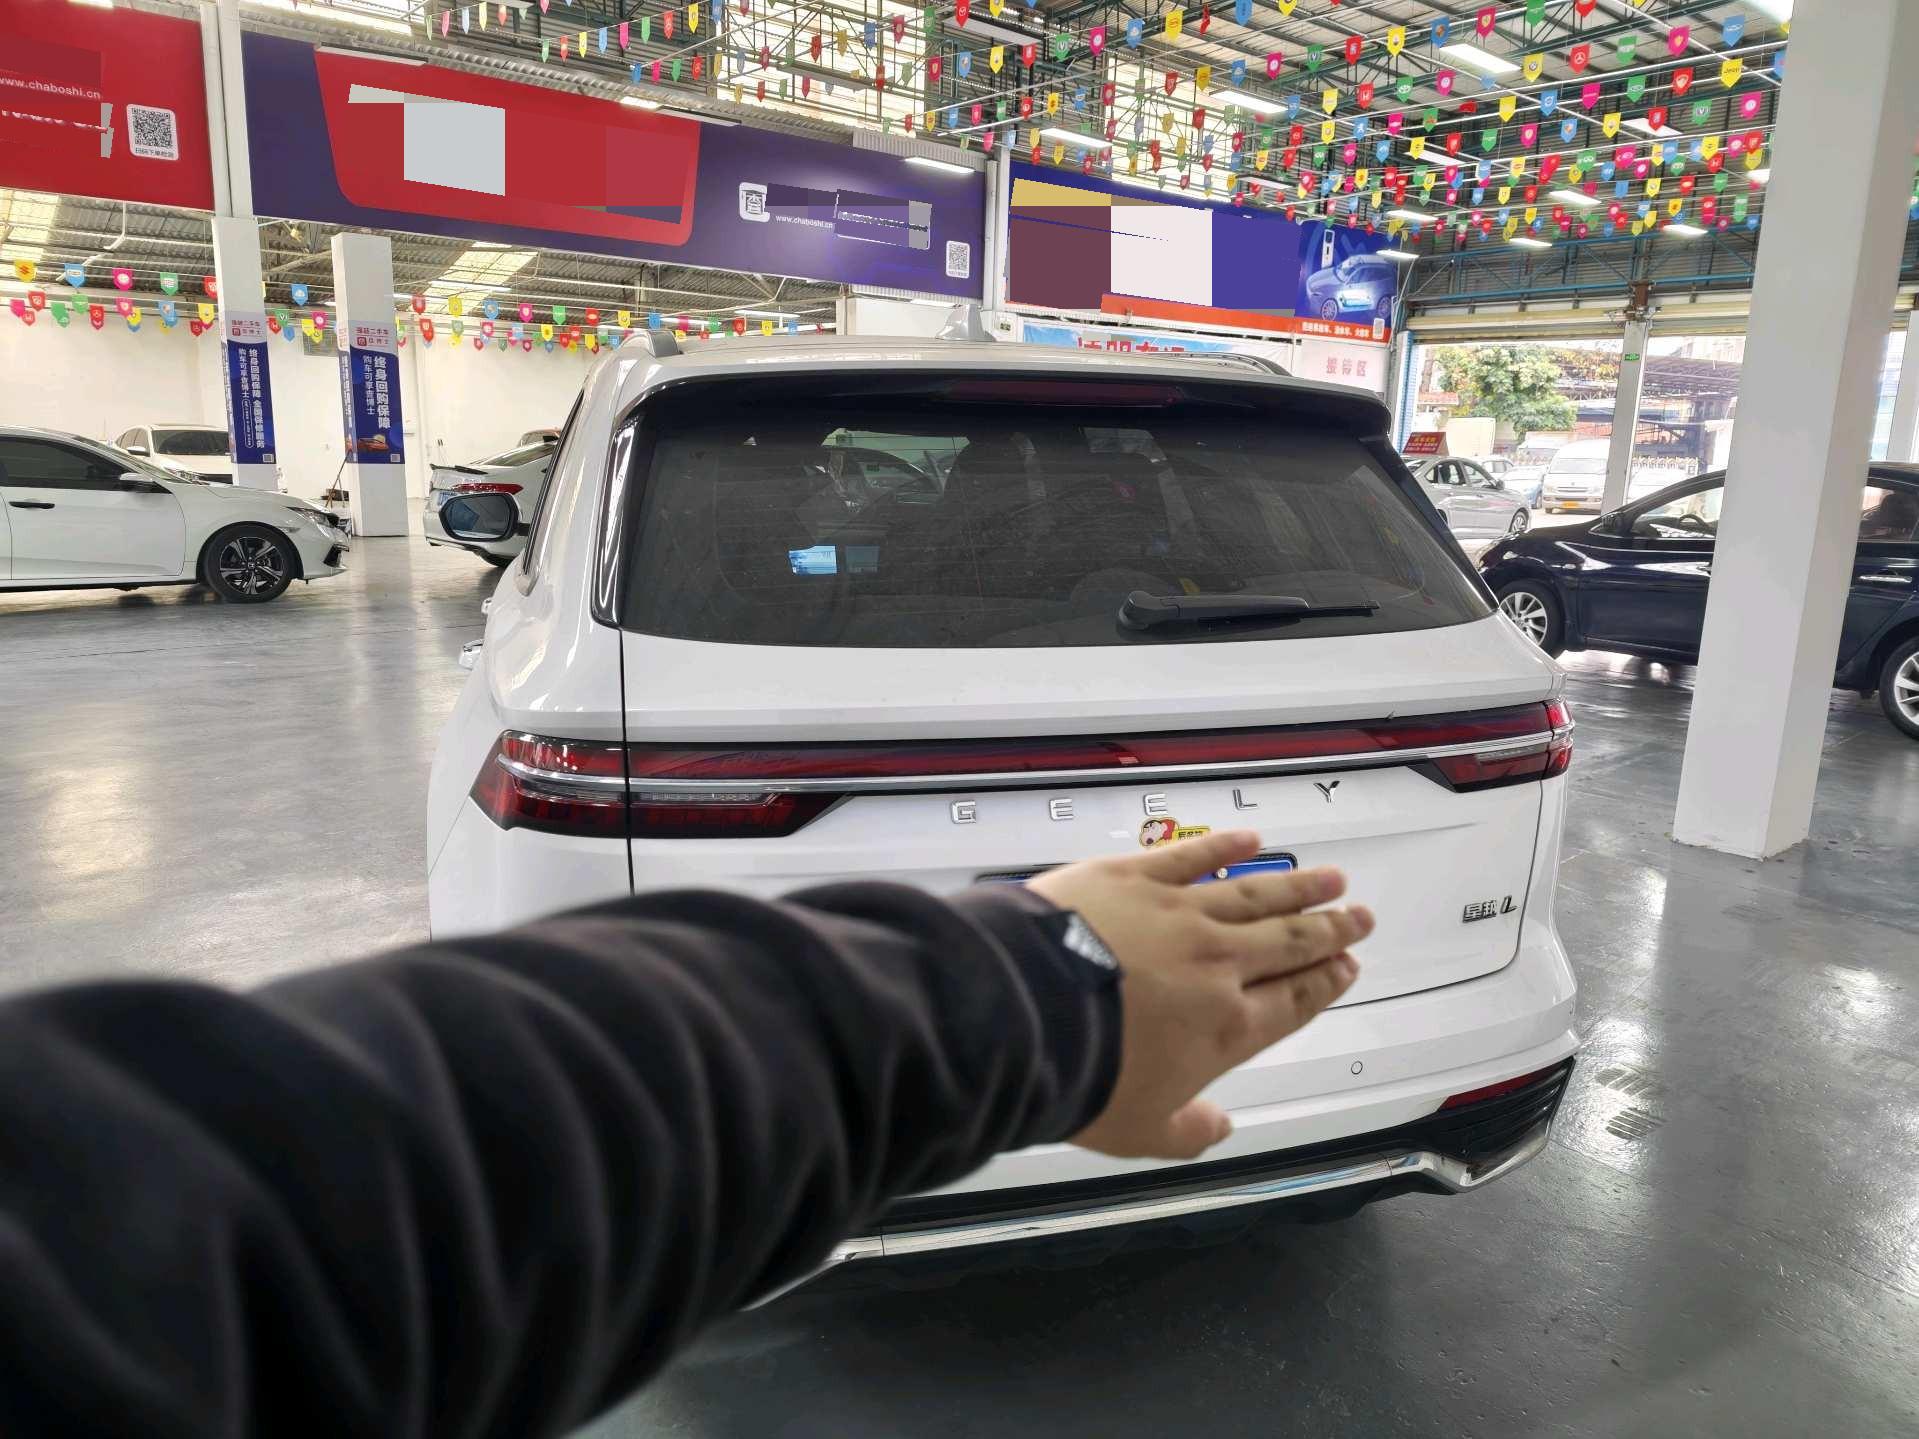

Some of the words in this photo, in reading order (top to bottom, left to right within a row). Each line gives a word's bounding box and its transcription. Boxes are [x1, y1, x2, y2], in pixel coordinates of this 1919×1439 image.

[374, 355, 391, 430] 终身回购保障
[950, 780, 1341, 825] GEELY
[1500, 894, 1519, 914] L
